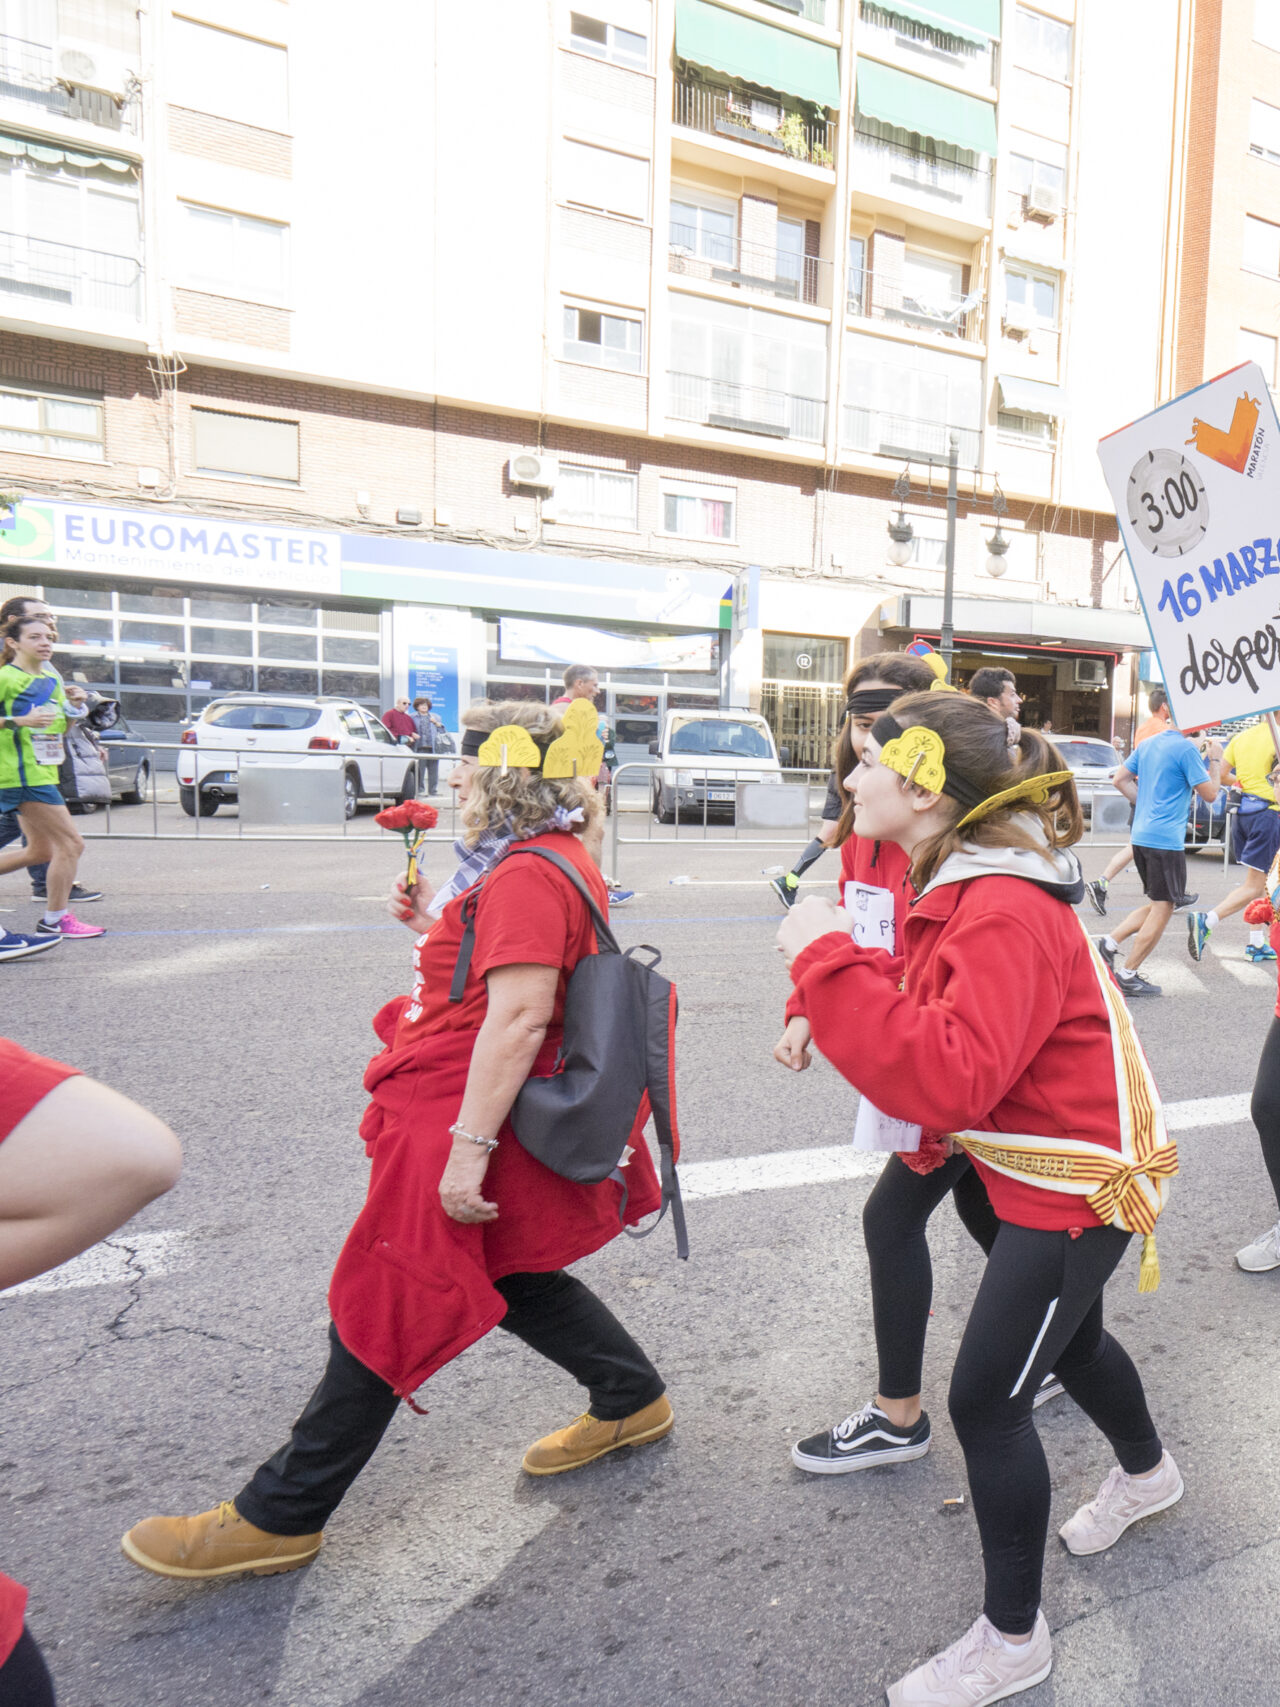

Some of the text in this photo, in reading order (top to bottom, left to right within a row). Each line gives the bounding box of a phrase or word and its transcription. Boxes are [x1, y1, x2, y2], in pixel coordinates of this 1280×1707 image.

[1140, 471, 1199, 533] 3:00
[64, 514, 329, 567] EUROMASTER
[65, 547, 215, 575] Mantenimiento
[222, 561, 249, 578] del
[1158, 572, 1202, 622] 16
